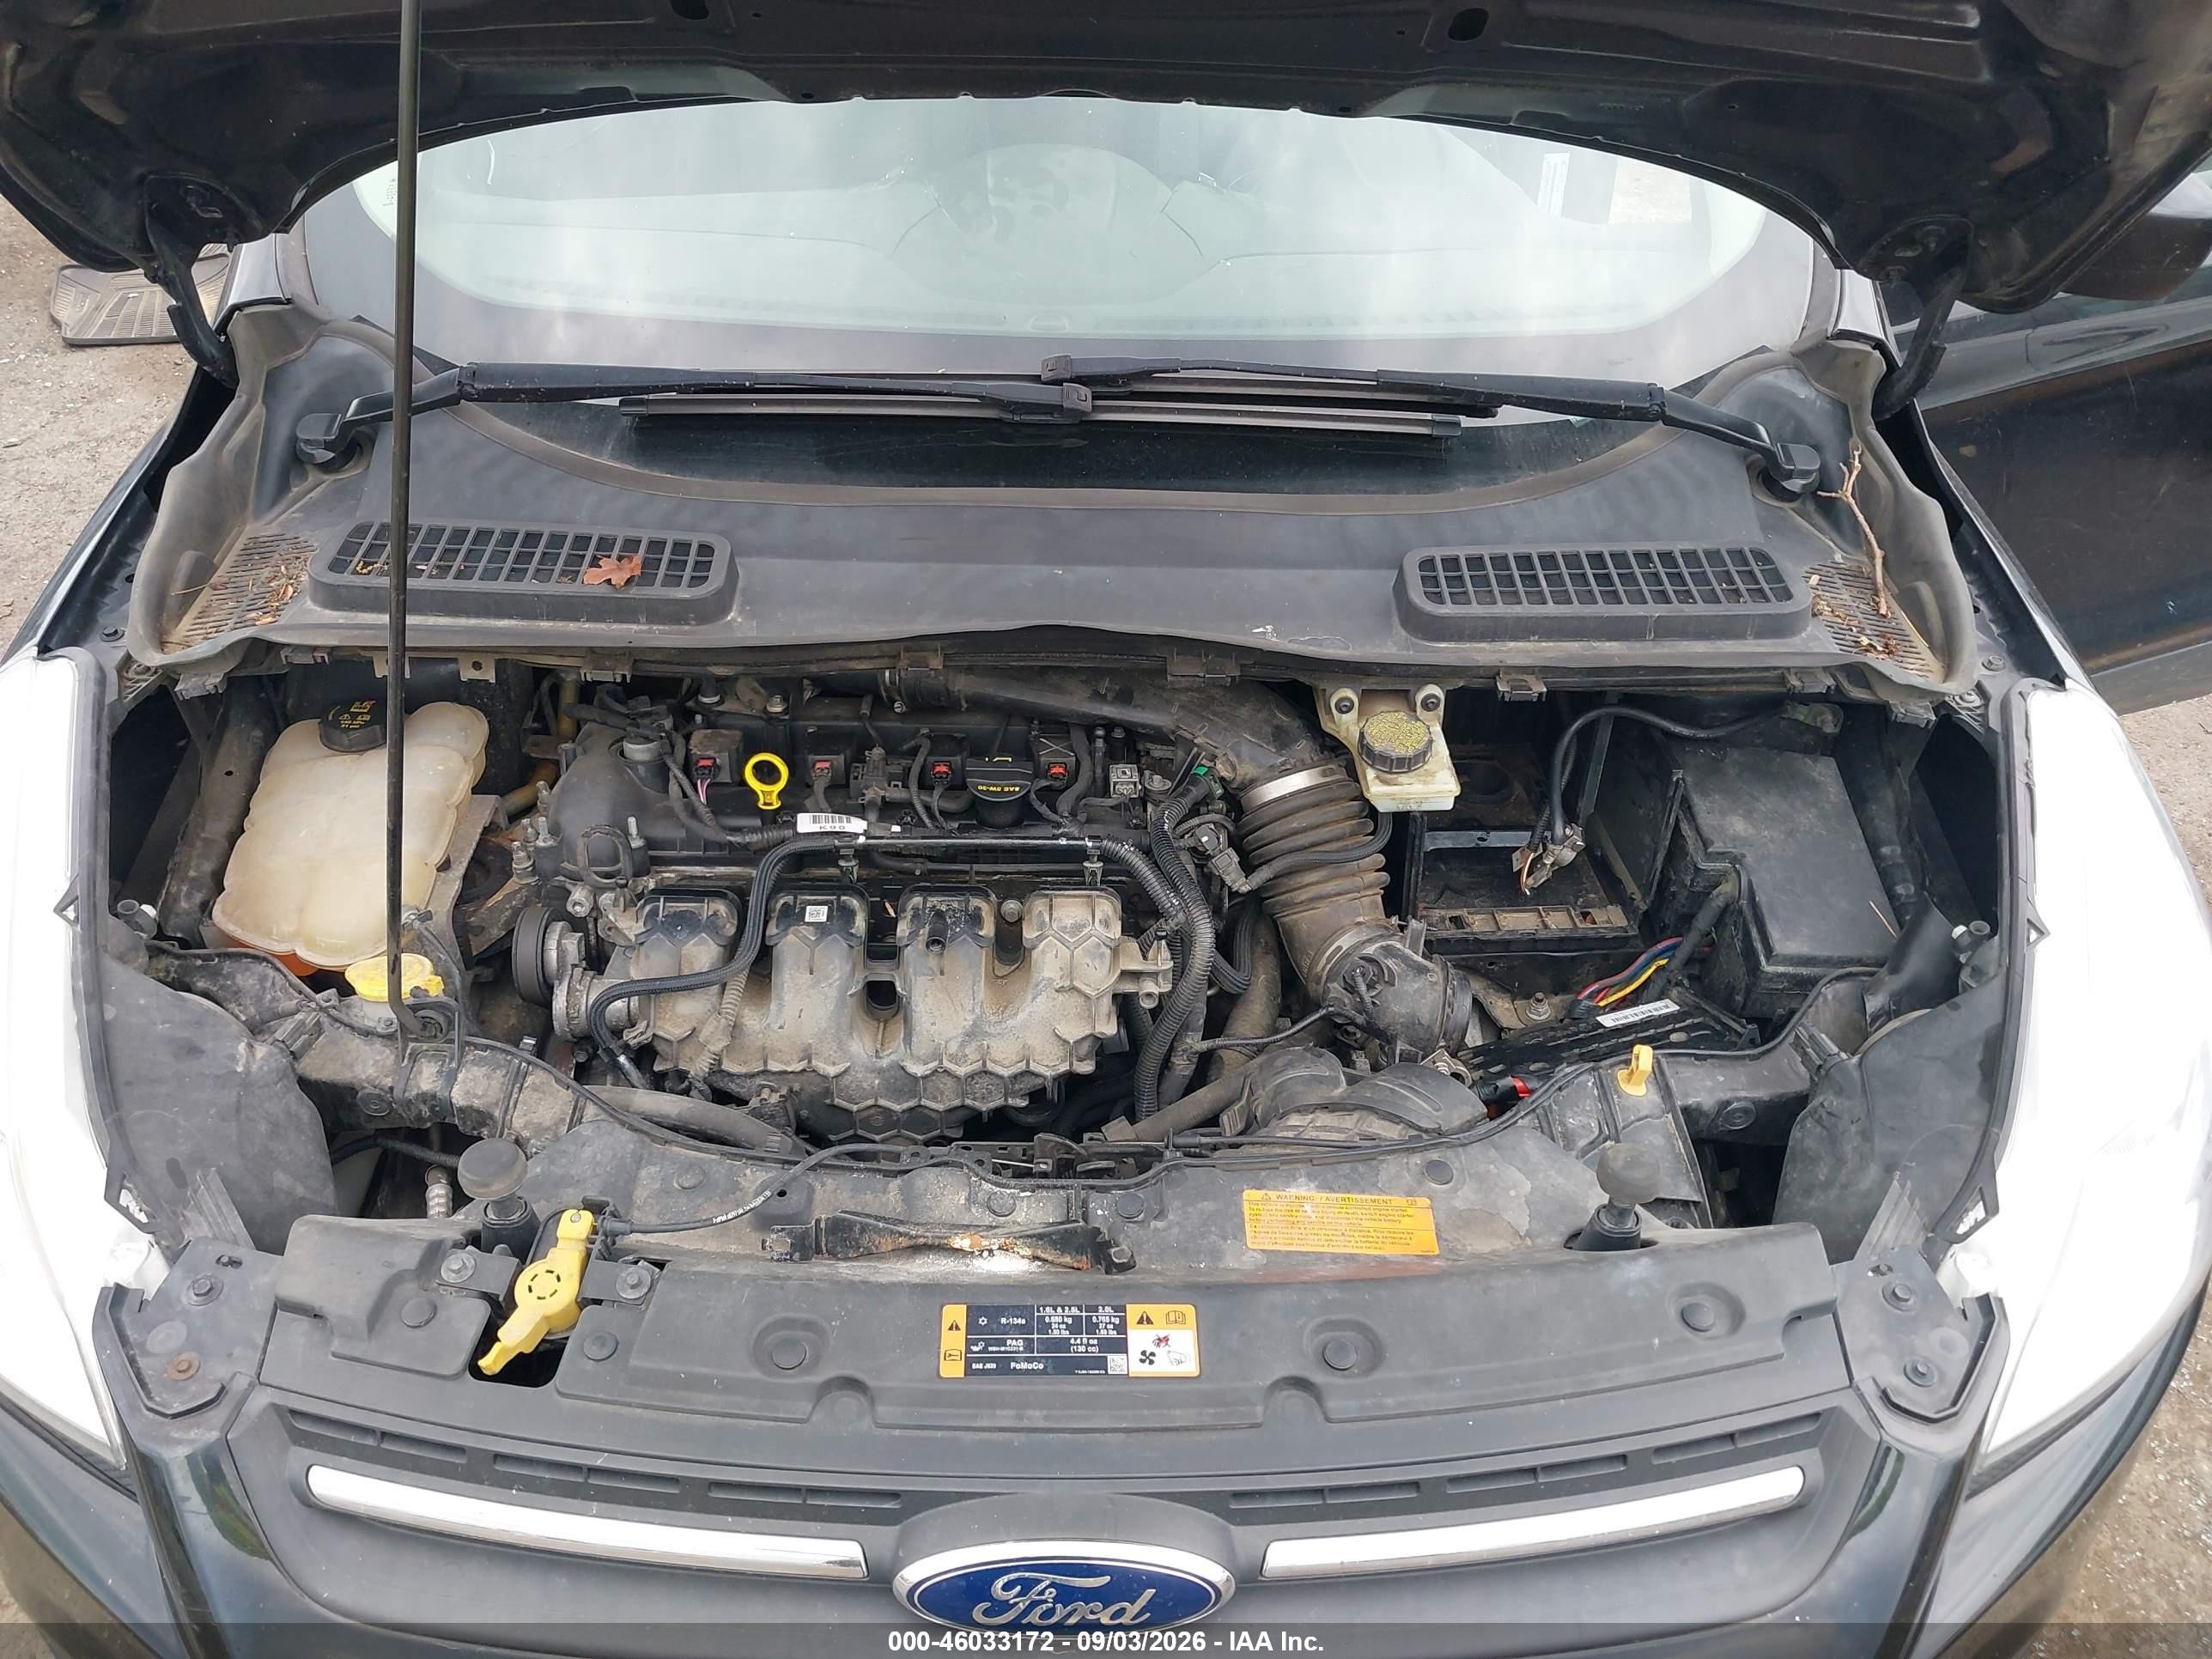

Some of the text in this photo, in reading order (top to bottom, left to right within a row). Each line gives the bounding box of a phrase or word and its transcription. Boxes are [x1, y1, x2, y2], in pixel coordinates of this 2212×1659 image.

[1325, 1195, 1393, 1205] AVERTISSEMENT
[1064, 1316, 1072, 1324] kg
[971, 1572, 1157, 1627] Ford
